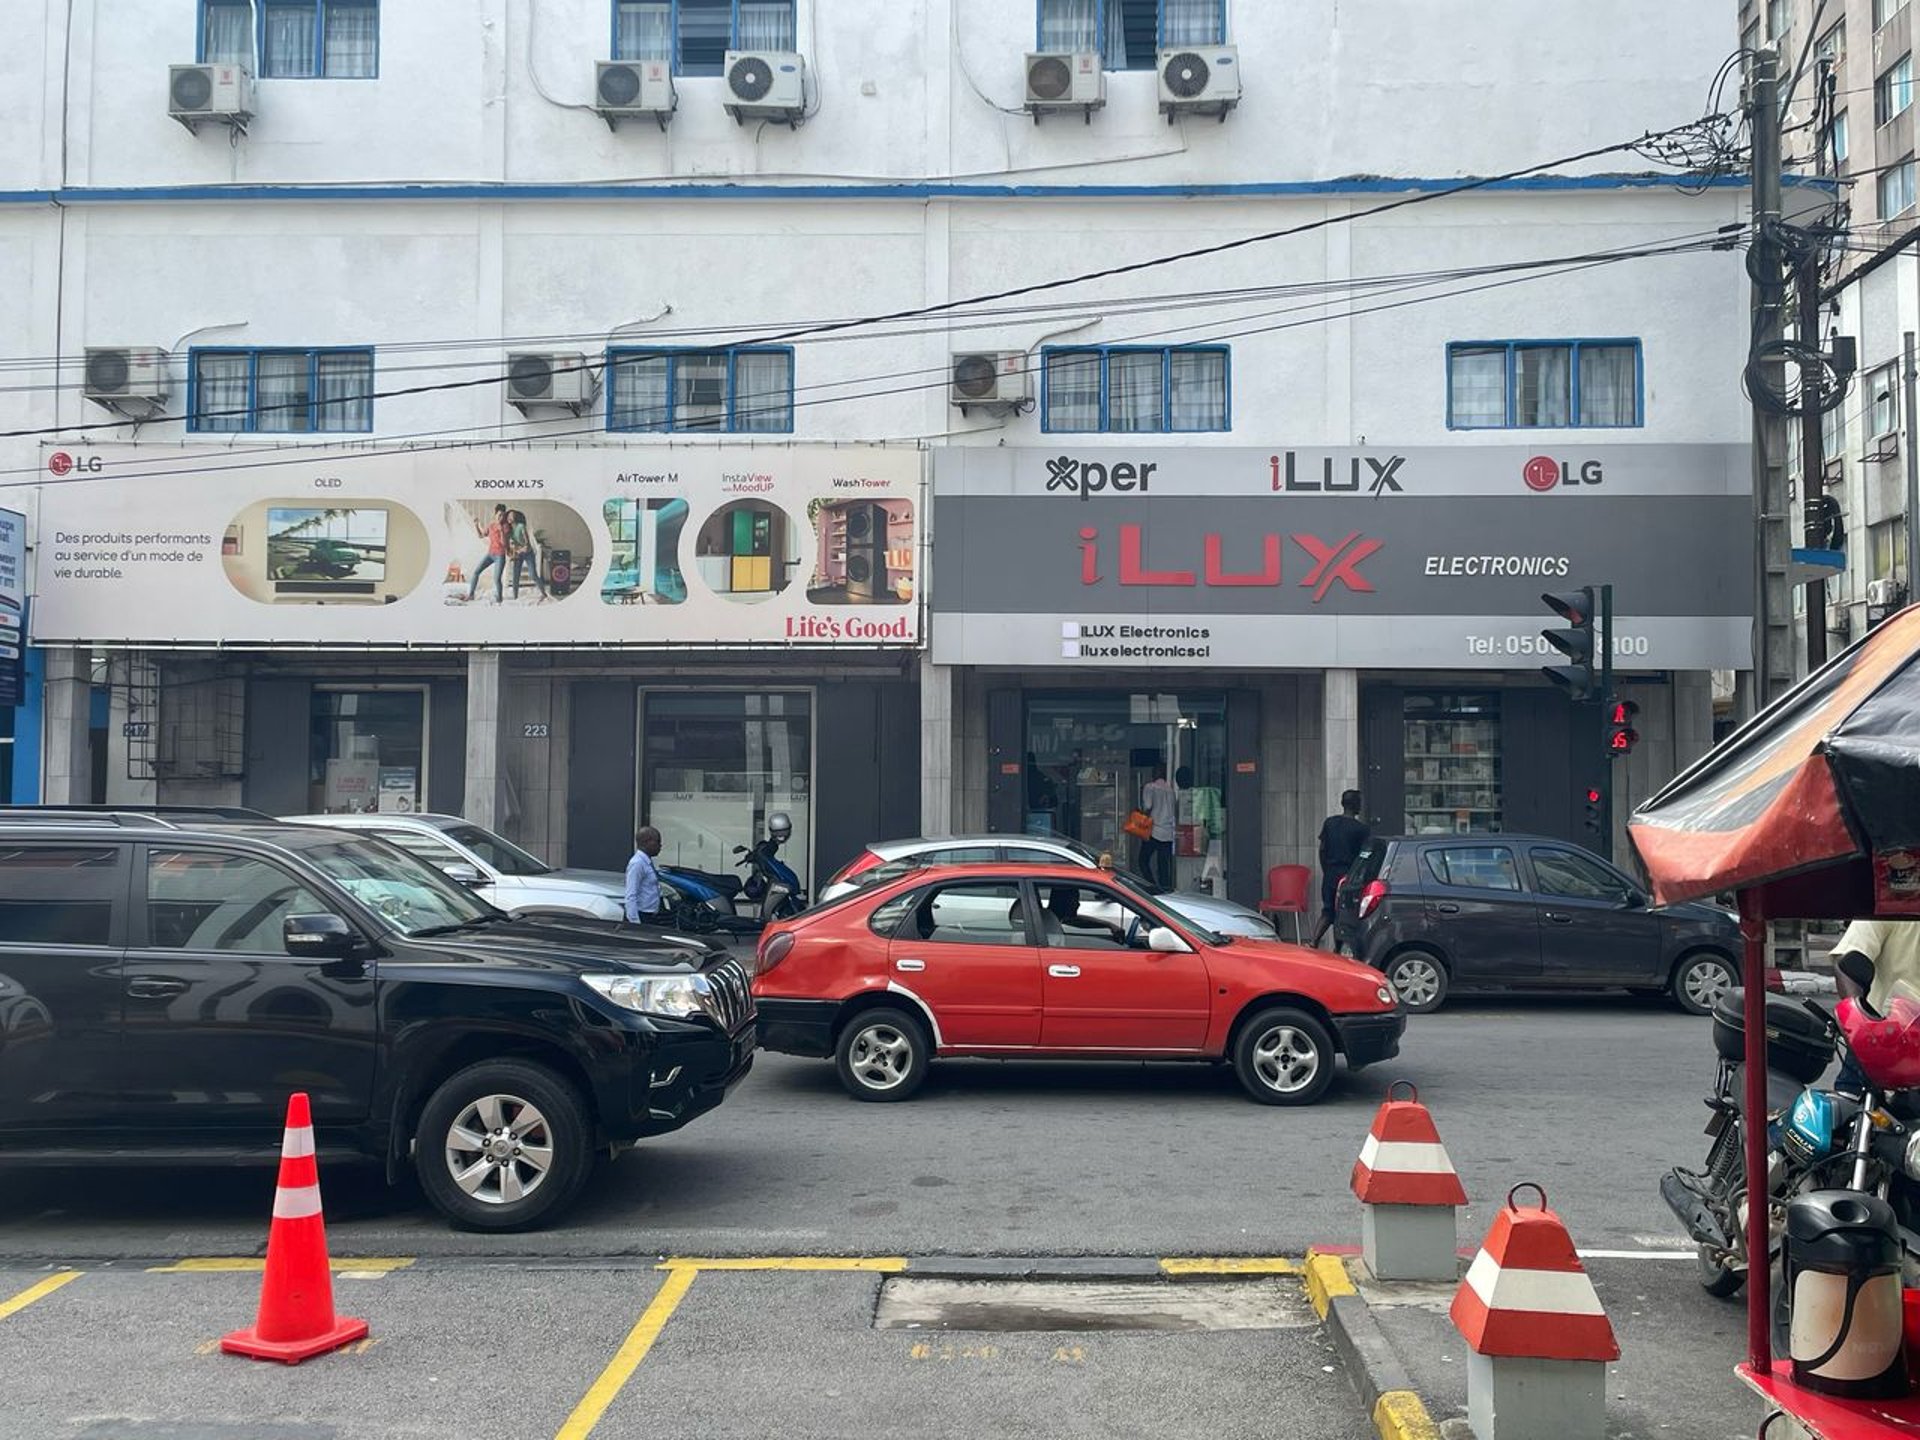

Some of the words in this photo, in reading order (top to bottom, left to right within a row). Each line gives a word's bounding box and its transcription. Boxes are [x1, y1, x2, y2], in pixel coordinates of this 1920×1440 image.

[76, 456, 103, 472] LG
[616, 473, 666, 484] AirTower
[668, 473, 679, 483] M
[722, 473, 773, 483] InstaView
[1561, 460, 1603, 485] LG
[314, 478, 342, 488] OLED
[474, 479, 516, 489] XBOOM
[733, 483, 775, 493] MoodUP
[833, 478, 892, 488] WashTower
[55, 532, 80, 545] Des
[82, 531, 132, 547] produits
[135, 531, 212, 547] performants
[55, 551, 71, 562] au
[73, 550, 118, 562] service
[120, 549, 147, 562] d'un
[150, 549, 185, 562] mode
[187, 549, 204, 562] de
[1424, 555, 1570, 577] ELECTRONICS
[54, 568, 72, 579] vie
[845, 617, 914, 638] Good.
[1120, 625, 1210, 639] Electronics
[524, 724, 547, 737] 223
